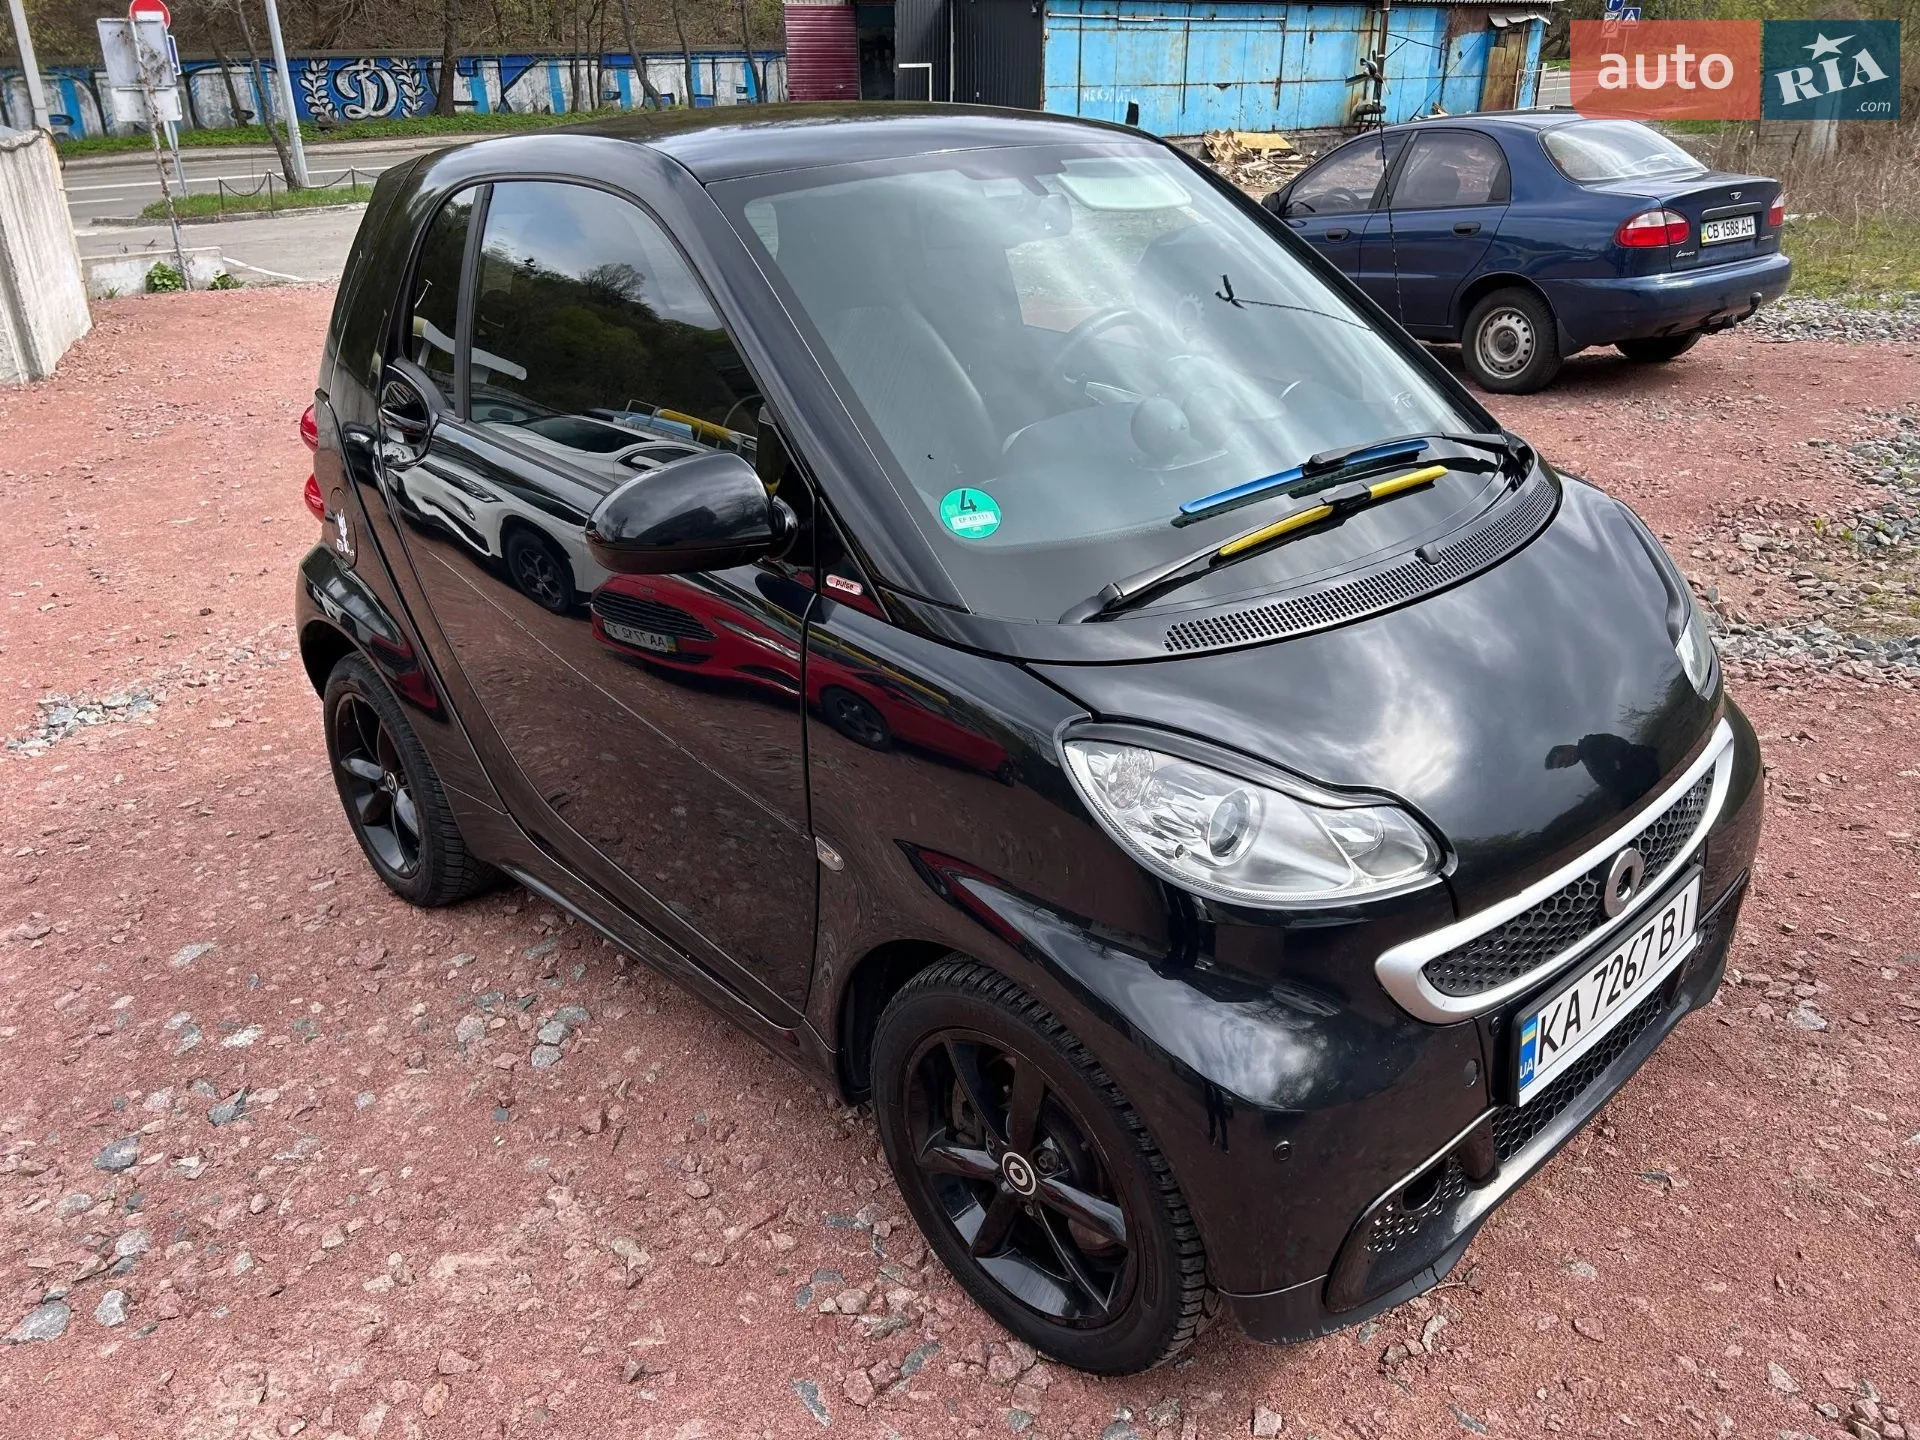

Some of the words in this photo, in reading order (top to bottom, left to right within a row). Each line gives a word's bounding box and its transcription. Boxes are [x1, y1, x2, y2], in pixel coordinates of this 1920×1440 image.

[1706, 223, 1720, 239] CB
[1721, 220, 1740, 237] 1588
[1741, 218, 1754, 233] AH
[960, 490, 977, 512] 4
[835, 580, 854, 591] pulse
[1537, 987, 1581, 1066] KA
[1590, 924, 1655, 1020] 7267
[1658, 893, 1689, 961] BI
[1520, 1058, 1534, 1078] UA
